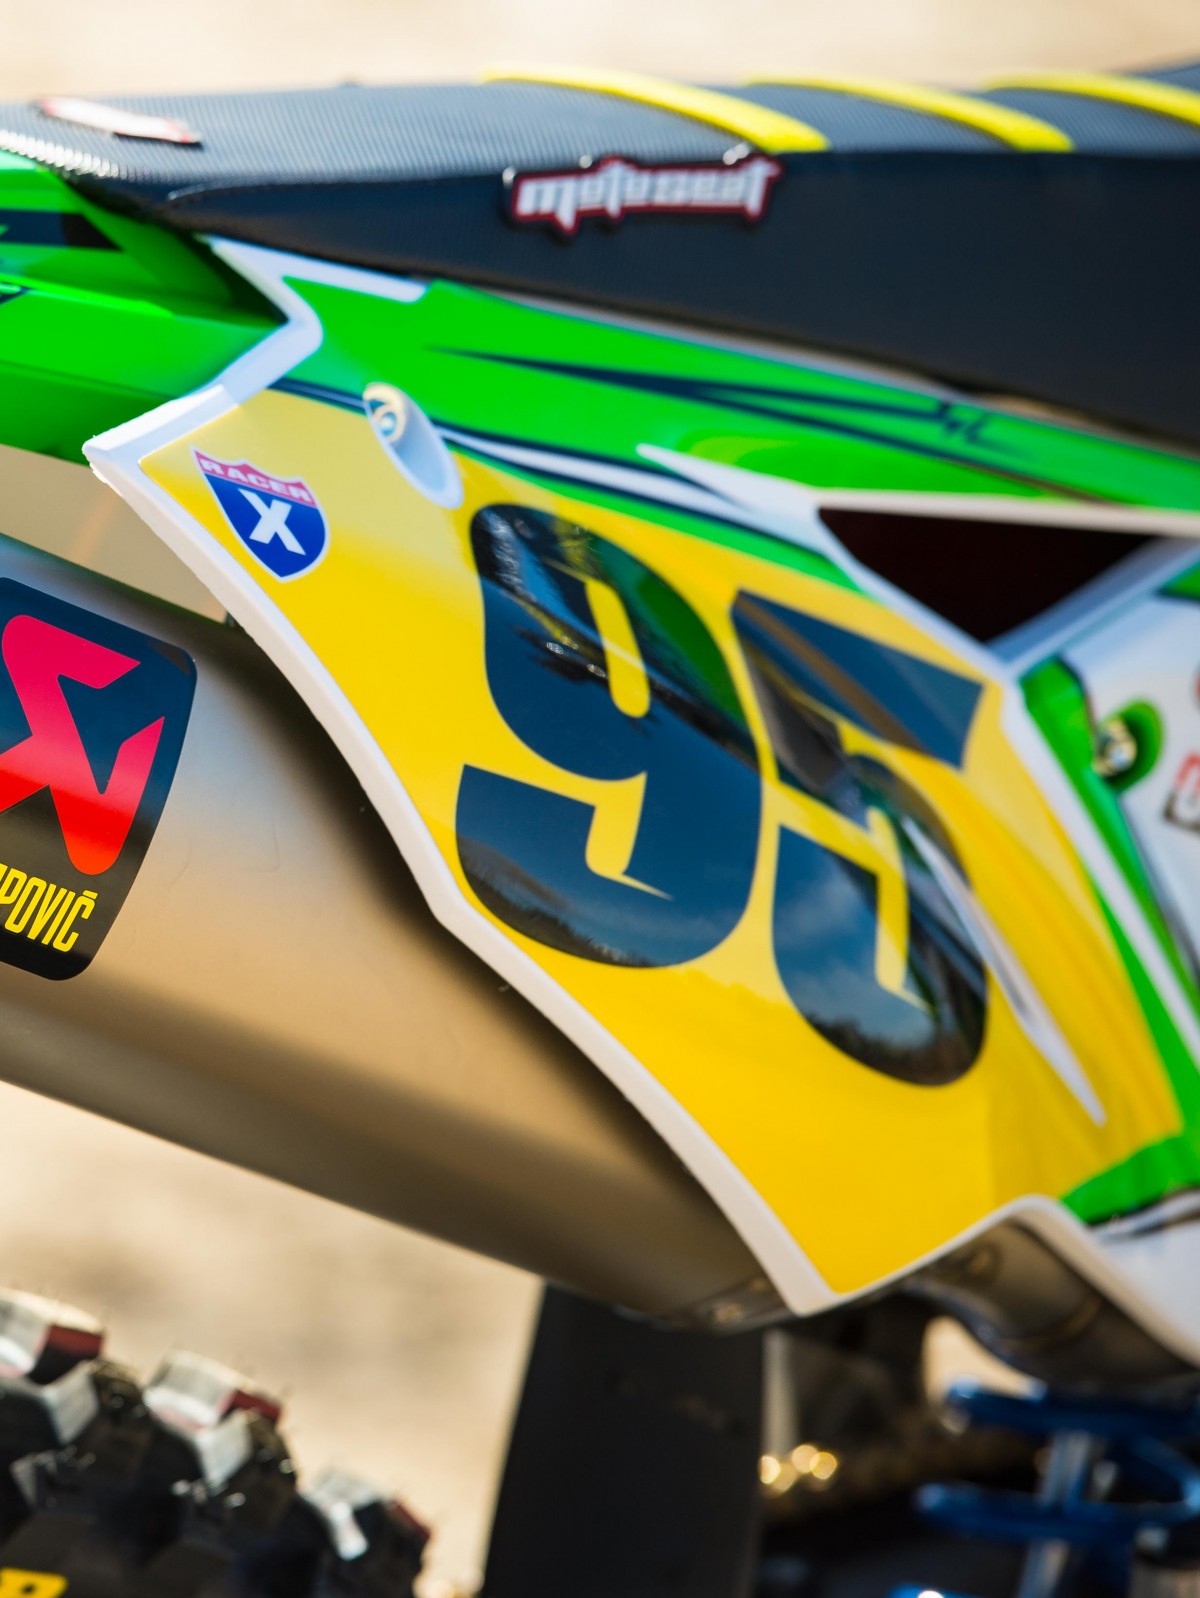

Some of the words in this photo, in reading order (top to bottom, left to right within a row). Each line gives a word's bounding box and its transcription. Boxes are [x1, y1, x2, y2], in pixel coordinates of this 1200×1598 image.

[200, 458, 312, 504] RACER
[237, 487, 306, 556] X
[455, 502, 989, 1088] 95
